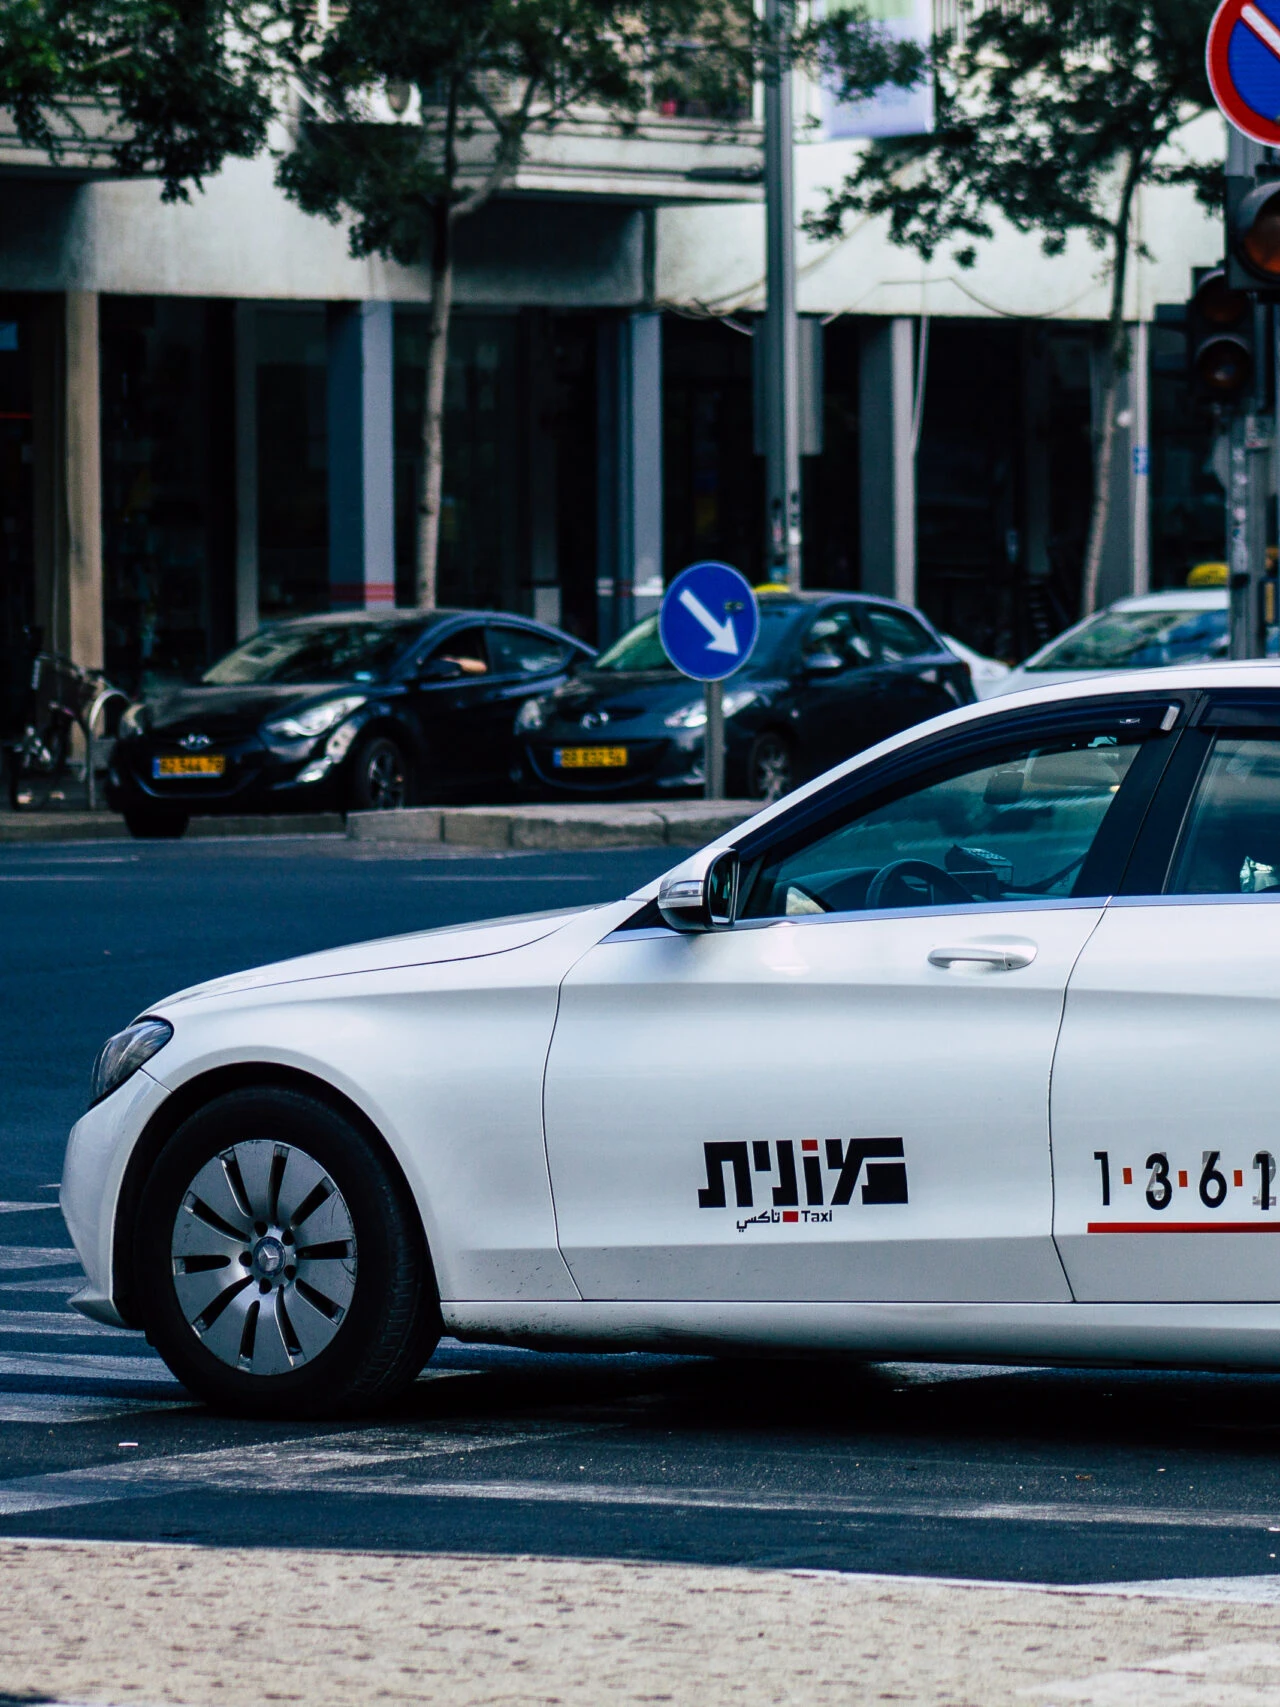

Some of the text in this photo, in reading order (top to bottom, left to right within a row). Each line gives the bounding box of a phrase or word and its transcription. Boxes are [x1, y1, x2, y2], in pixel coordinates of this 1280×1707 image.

[698, 1137, 909, 1208] מונית
[736, 1209, 833, 1233] تاكسي Taxi
